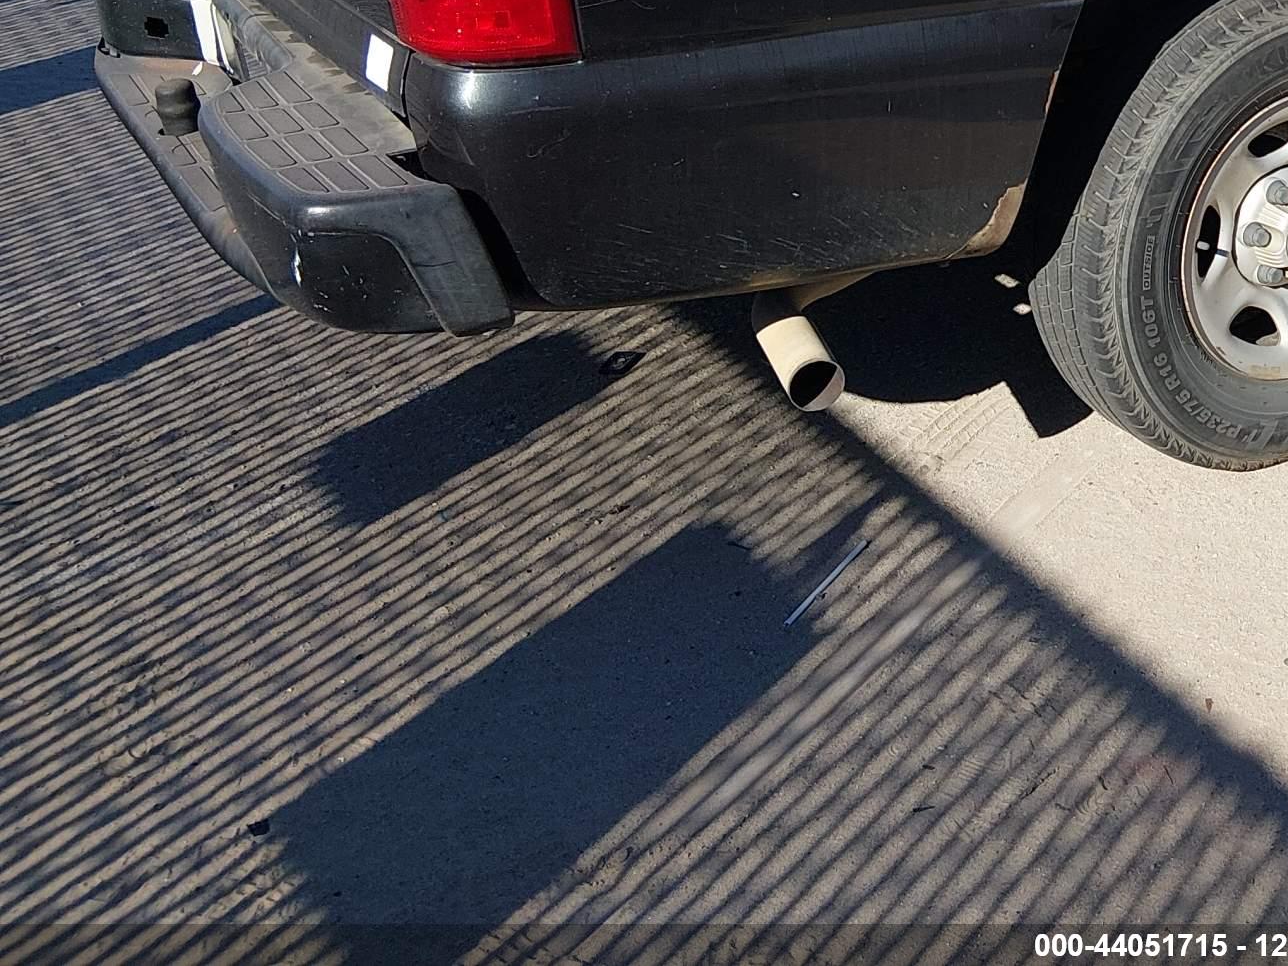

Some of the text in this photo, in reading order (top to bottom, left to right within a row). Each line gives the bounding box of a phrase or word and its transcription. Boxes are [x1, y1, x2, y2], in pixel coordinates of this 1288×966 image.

[1140, 236, 1242, 439] P235/75 R16 106T OUTSIDE
